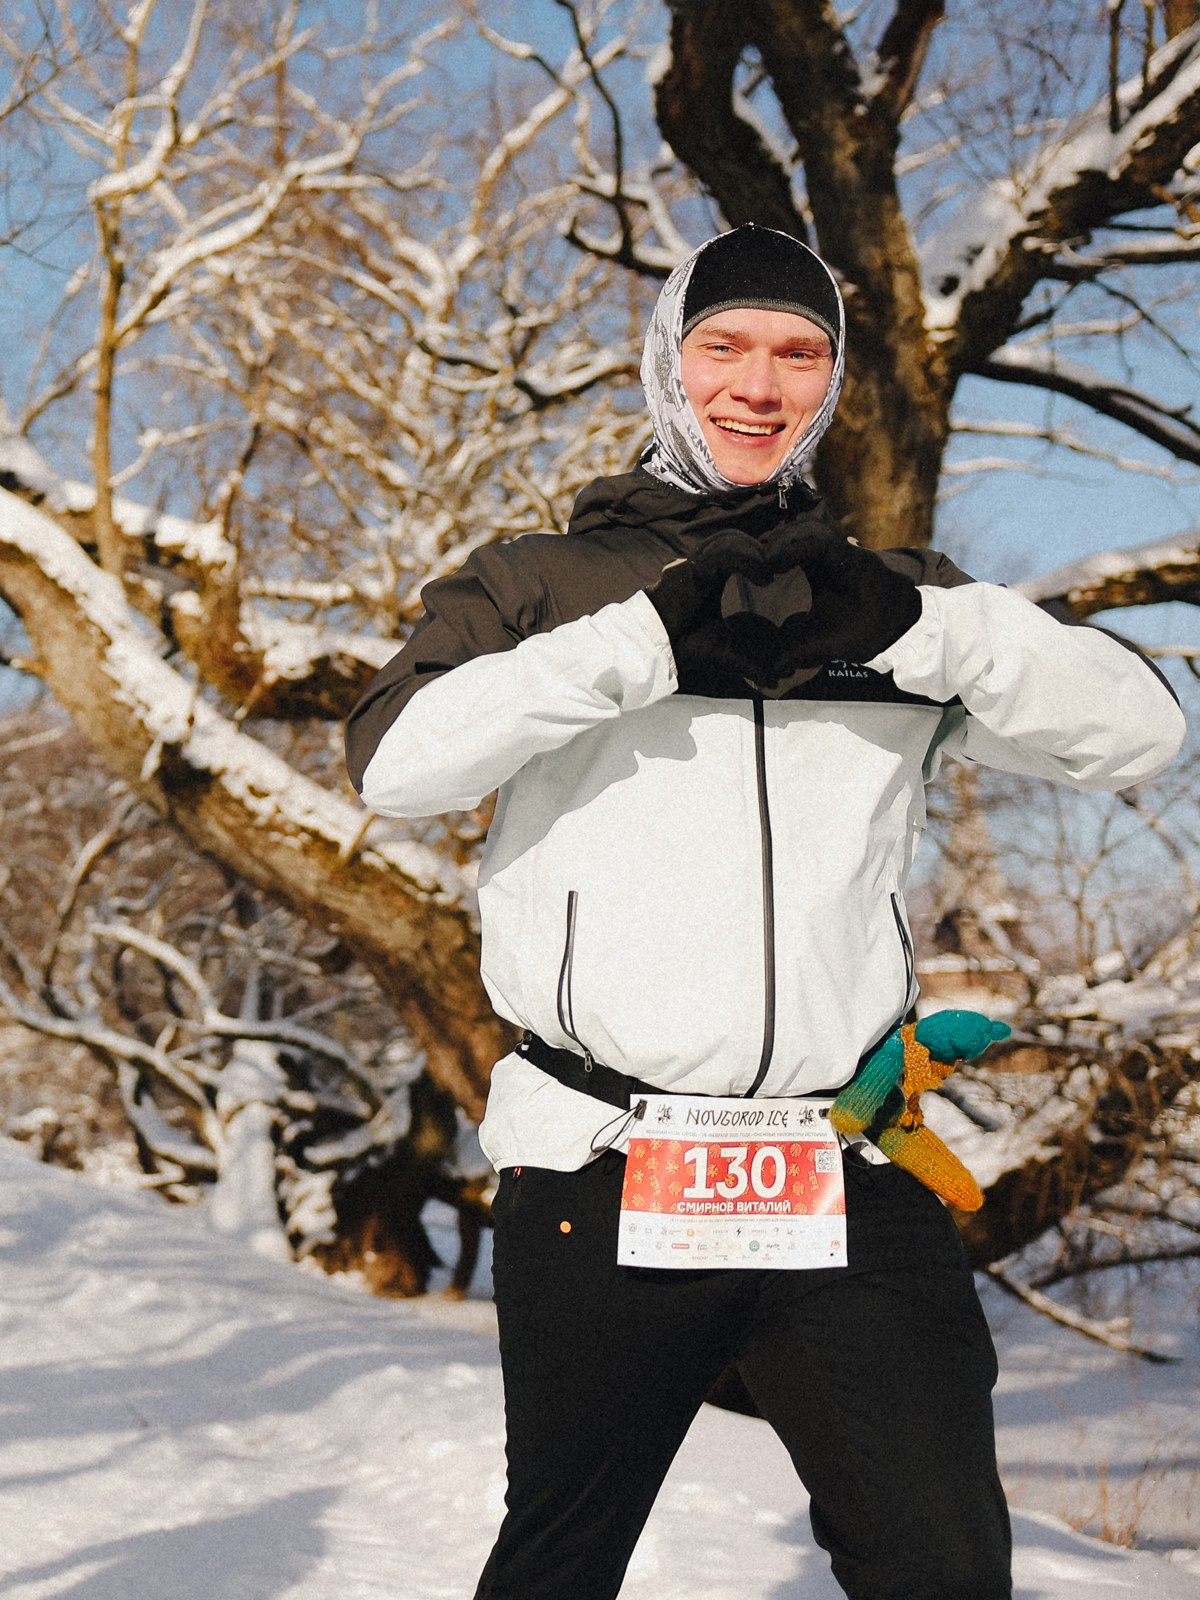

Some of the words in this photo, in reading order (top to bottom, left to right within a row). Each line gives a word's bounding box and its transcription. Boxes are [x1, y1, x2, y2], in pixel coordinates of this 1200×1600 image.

[828, 670, 869, 678] KAILAS
[686, 1107, 765, 1127] NOVGOROD
[766, 1110, 789, 1128] ICE
[683, 1145, 787, 1199] 130
[677, 1201, 735, 1213] СМИРНОВ
[736, 1200, 792, 1213] ВИТАЛИЙ
